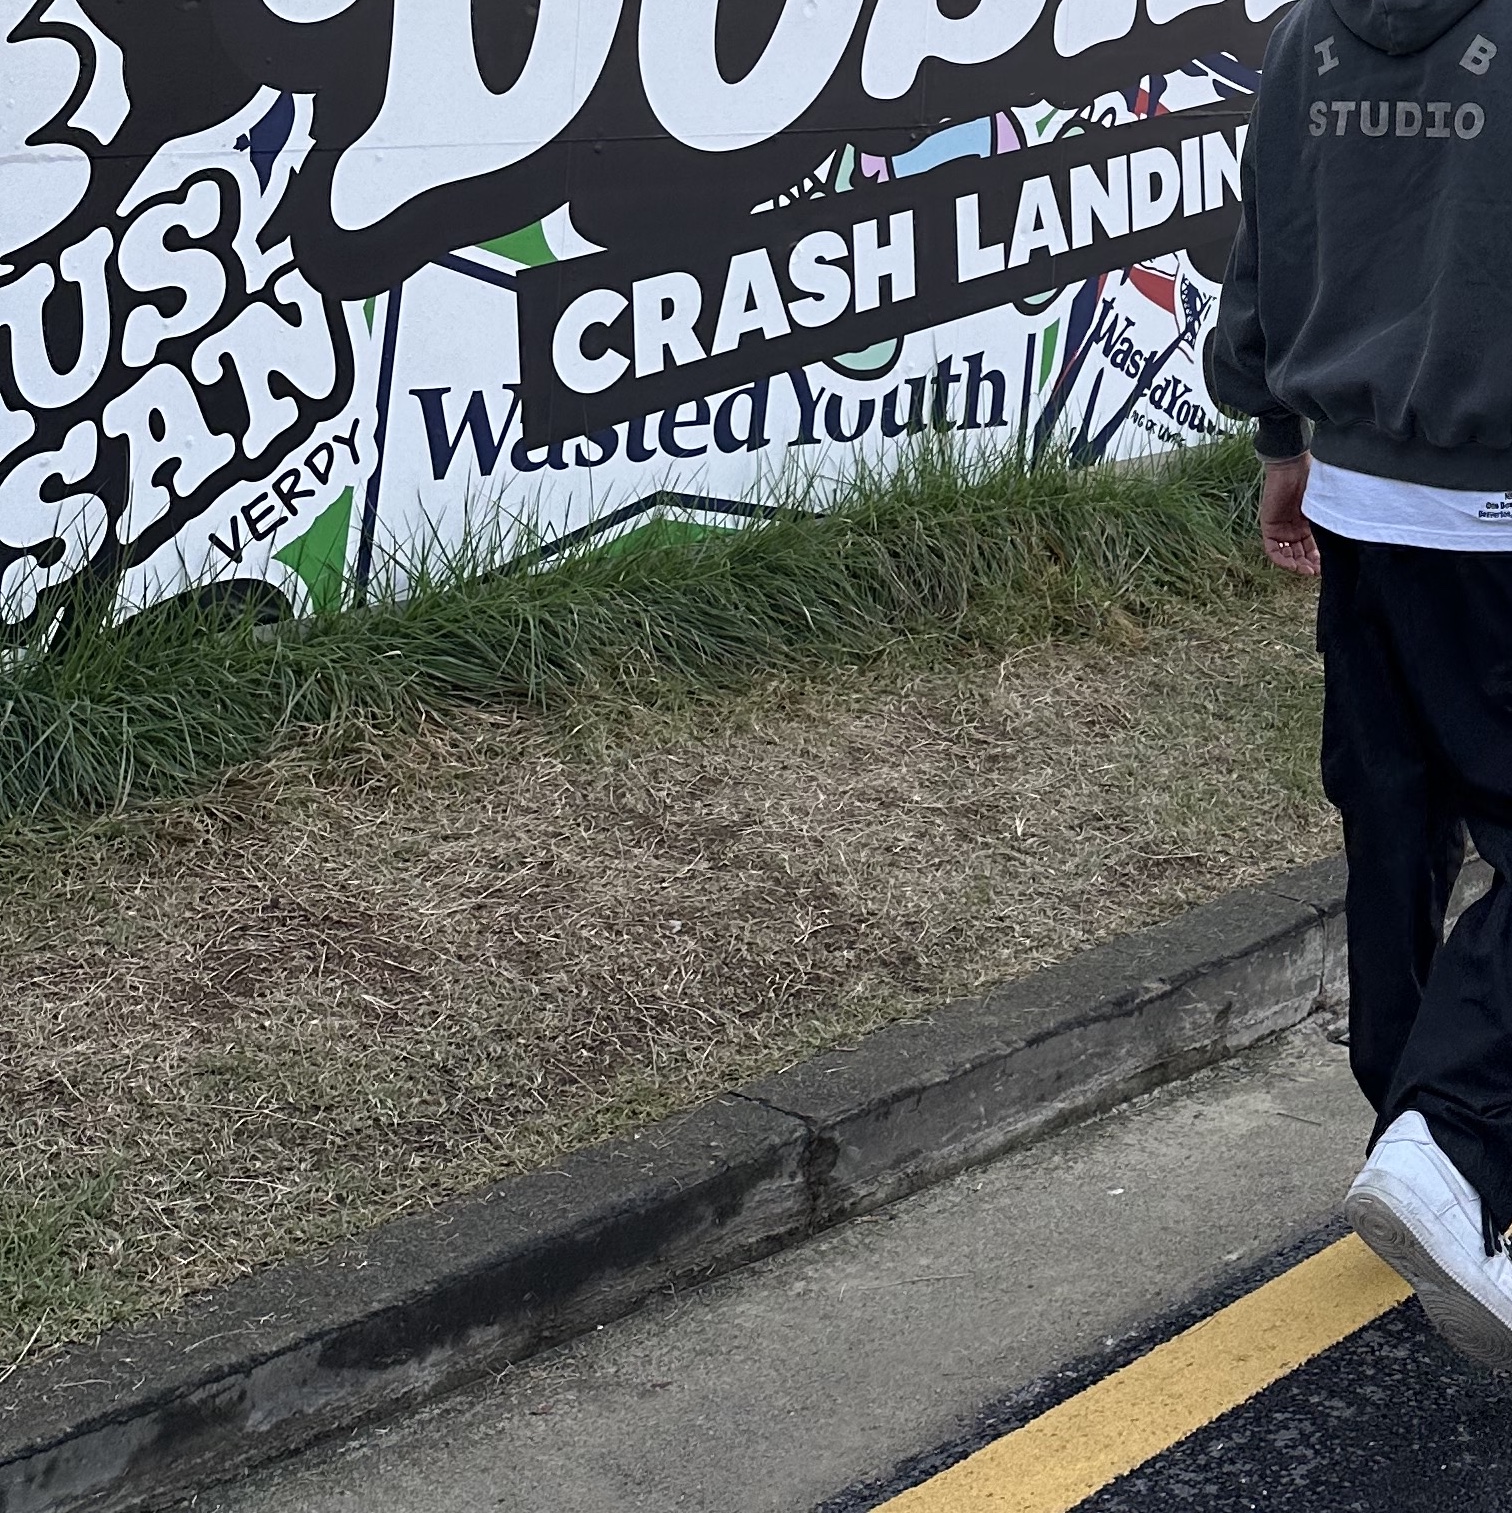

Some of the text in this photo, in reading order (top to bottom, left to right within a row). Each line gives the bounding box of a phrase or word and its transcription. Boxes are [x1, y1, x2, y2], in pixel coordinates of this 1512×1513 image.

[1309, 100, 1485, 140] STUDIO
[552, 123, 1247, 394] CRASH LANDIN
[208, 417, 360, 564] VERDY
